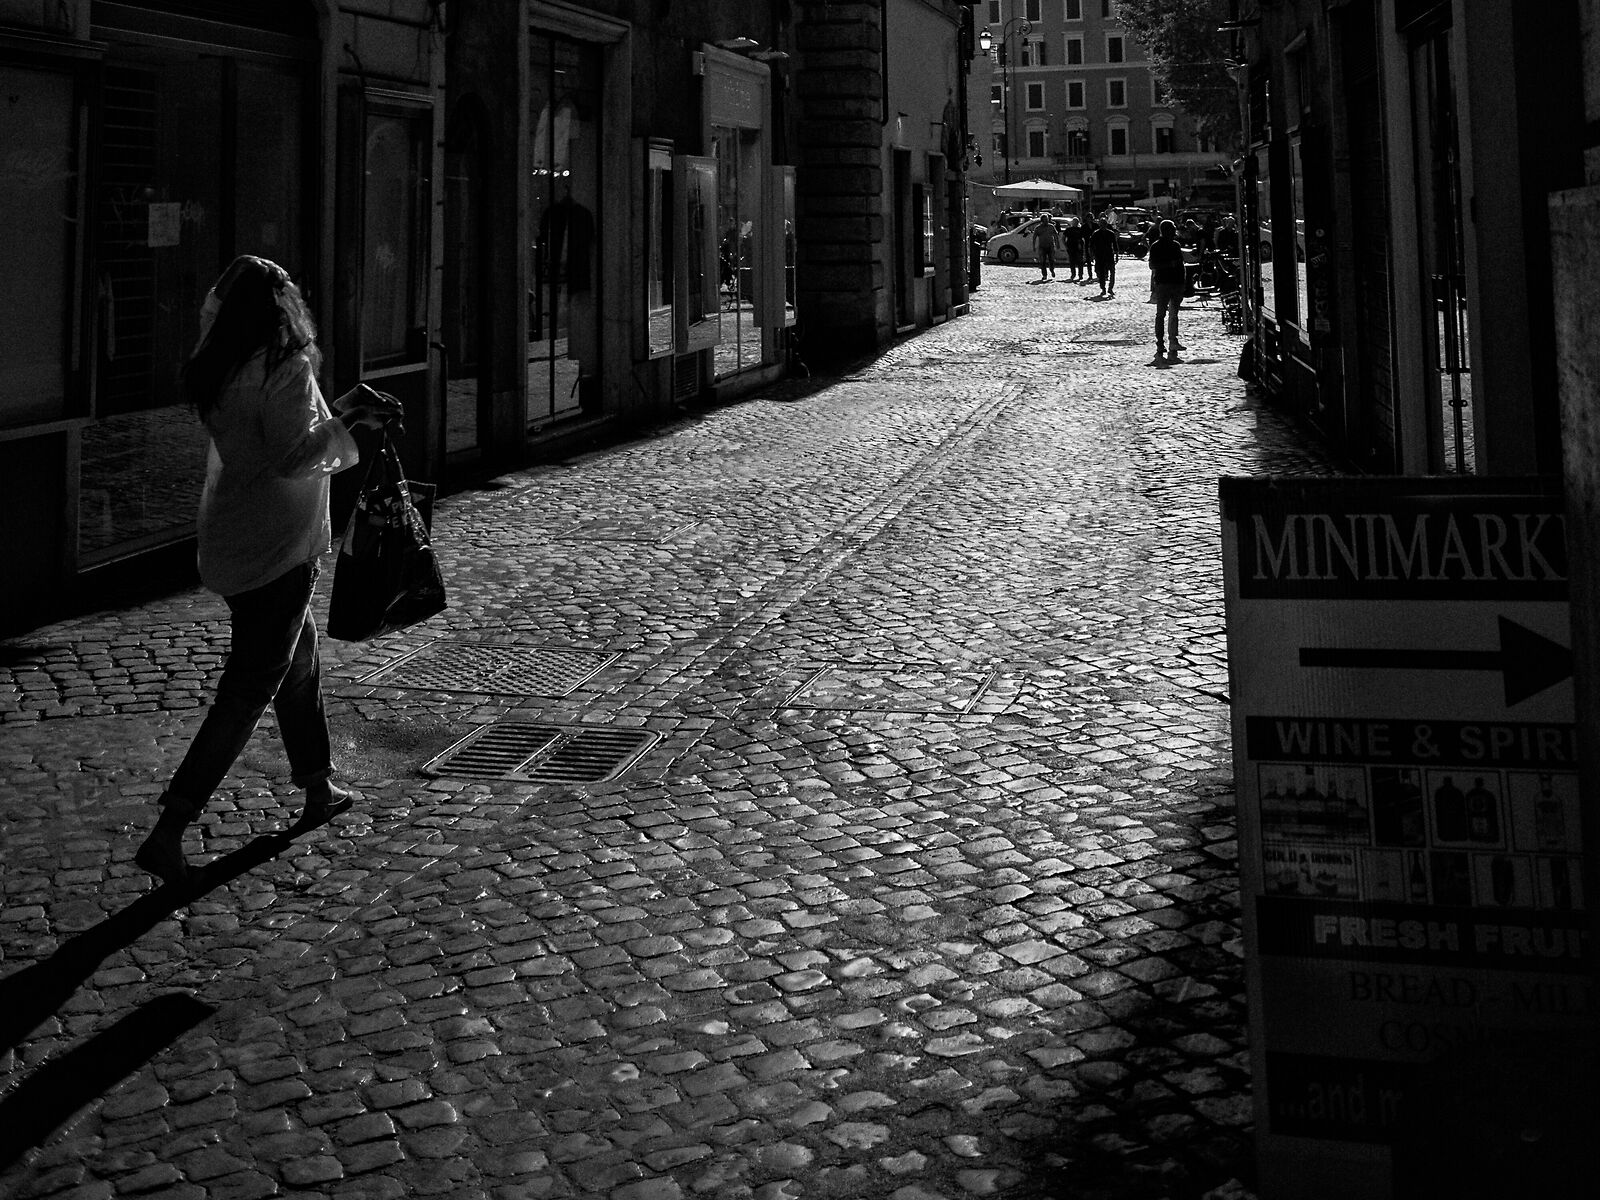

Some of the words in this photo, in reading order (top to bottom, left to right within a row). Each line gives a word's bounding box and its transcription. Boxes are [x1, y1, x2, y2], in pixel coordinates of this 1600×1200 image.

[1251, 512, 1569, 581] MINIMARK
[1275, 720, 1393, 757] WINE
[1411, 723, 1441, 759] &
[1313, 914, 1461, 952] FRESH
[1350, 971, 1477, 1008] BREAD
